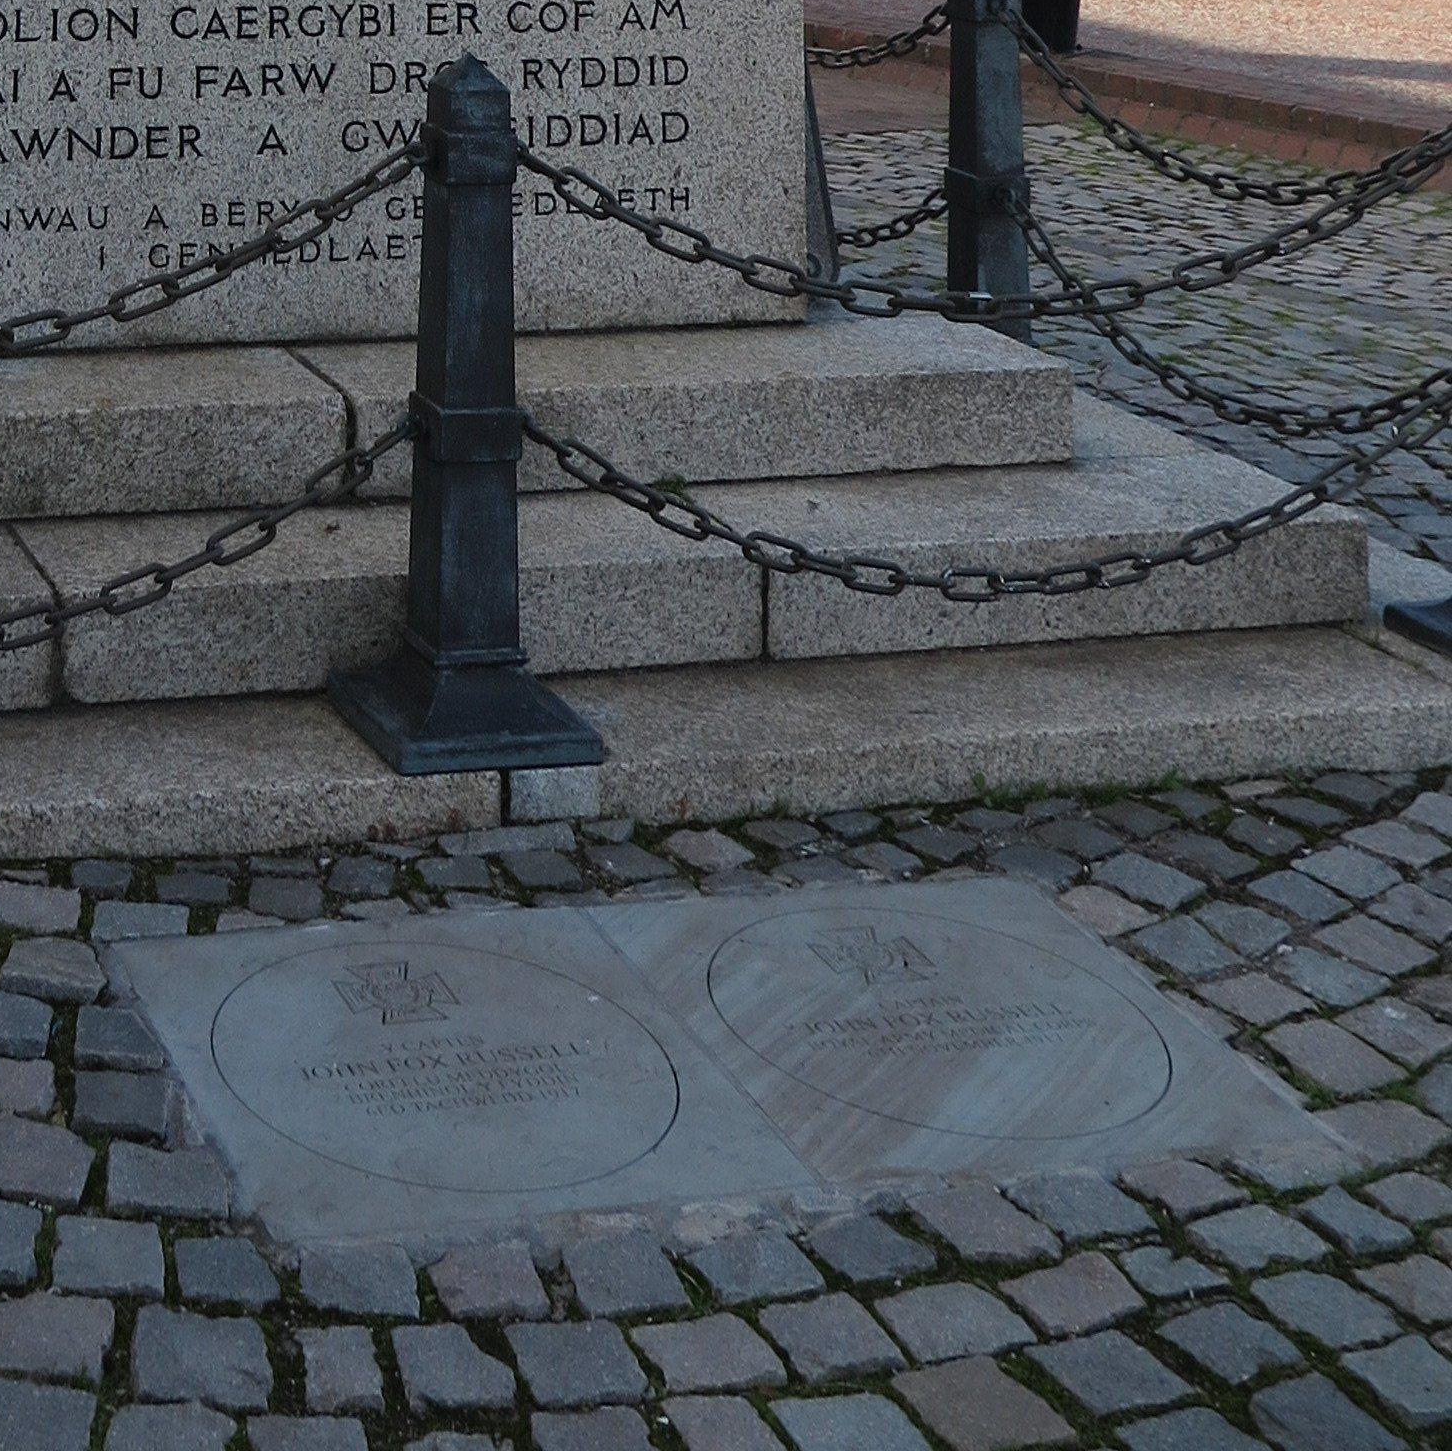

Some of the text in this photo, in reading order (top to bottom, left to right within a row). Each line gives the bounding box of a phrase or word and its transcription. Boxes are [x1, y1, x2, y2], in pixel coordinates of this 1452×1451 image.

[170, 3, 396, 41] CAERGYBI
[425, 2, 481, 36] ER
[506, 0, 595, 34] COF
[49, 69, 79, 102] A
[108, 66, 164, 101] FU
[195, 62, 336, 99] FARW
[521, 55, 690, 91] RYDDID
[257, 123, 289, 157] A
[145, 204, 169, 230] A
[99, 246, 106, 271] I
[804, 1002, 1073, 1036] JOHN FOX RUSSELL
[301, 1040, 590, 1081] JOHN FOX RUSSELL
